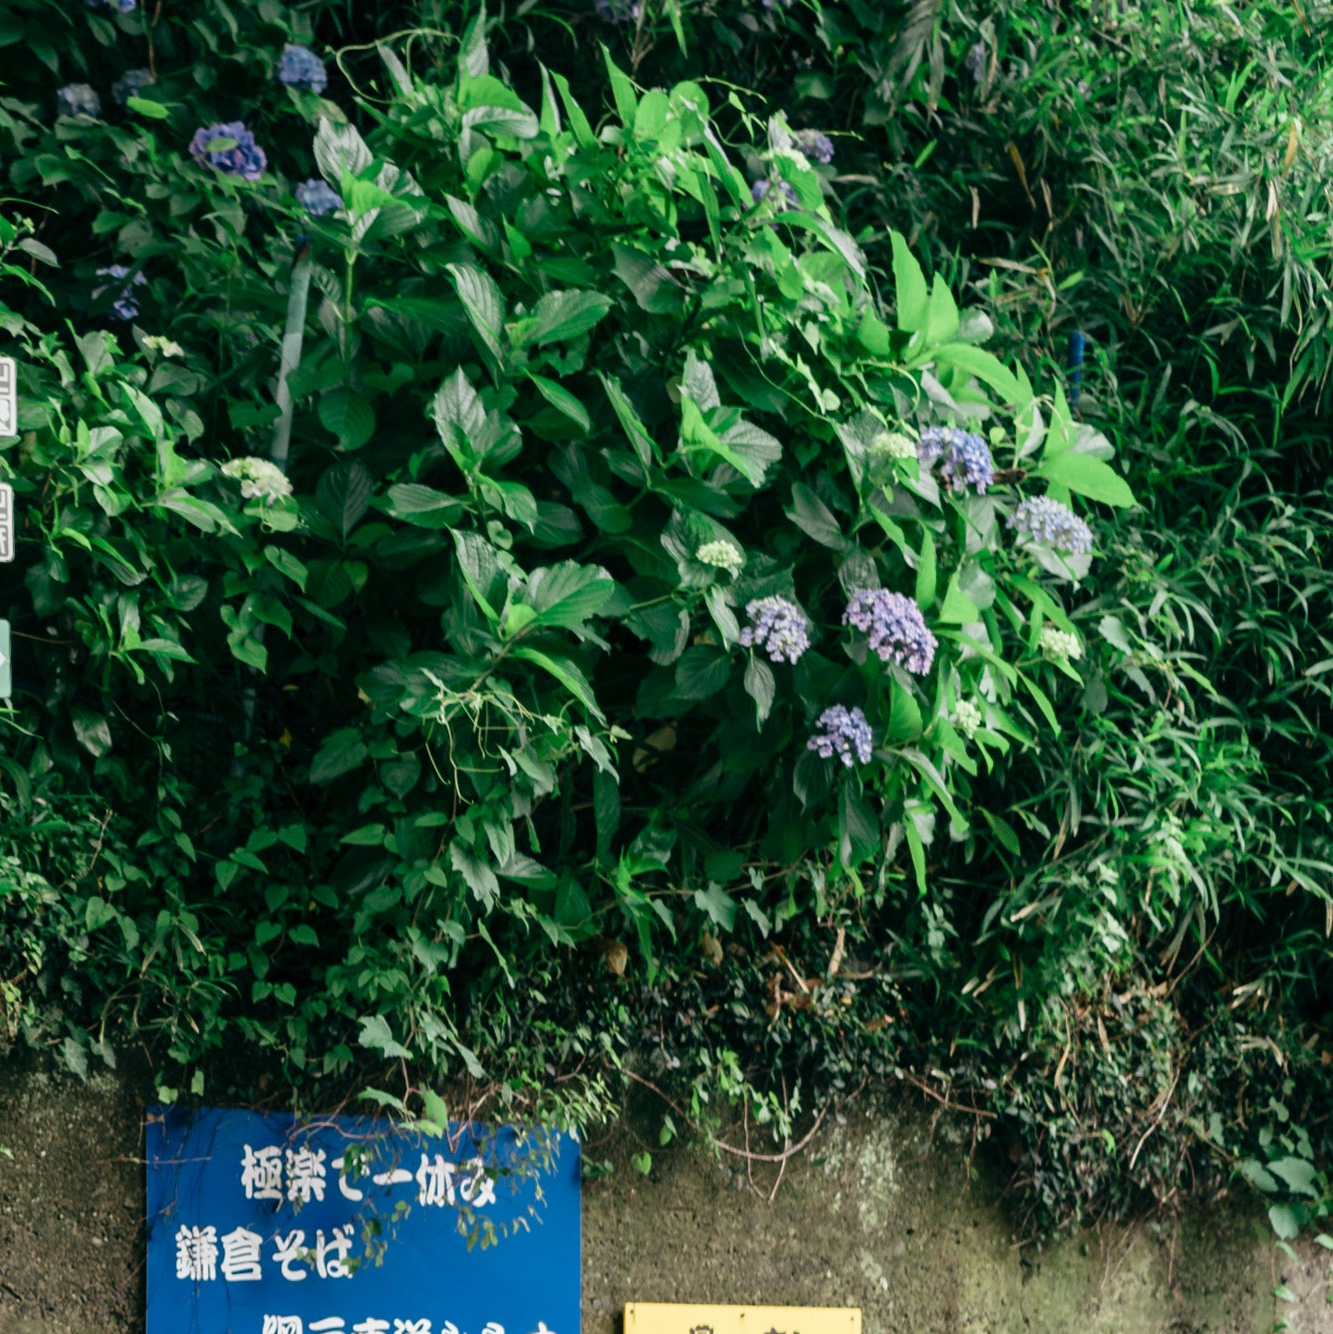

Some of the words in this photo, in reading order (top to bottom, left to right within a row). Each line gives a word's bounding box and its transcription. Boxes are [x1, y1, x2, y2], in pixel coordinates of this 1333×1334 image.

[240, 1143, 497, 1208] 極楽で一休み
[174, 1223, 355, 1282] 鎌倉そば
